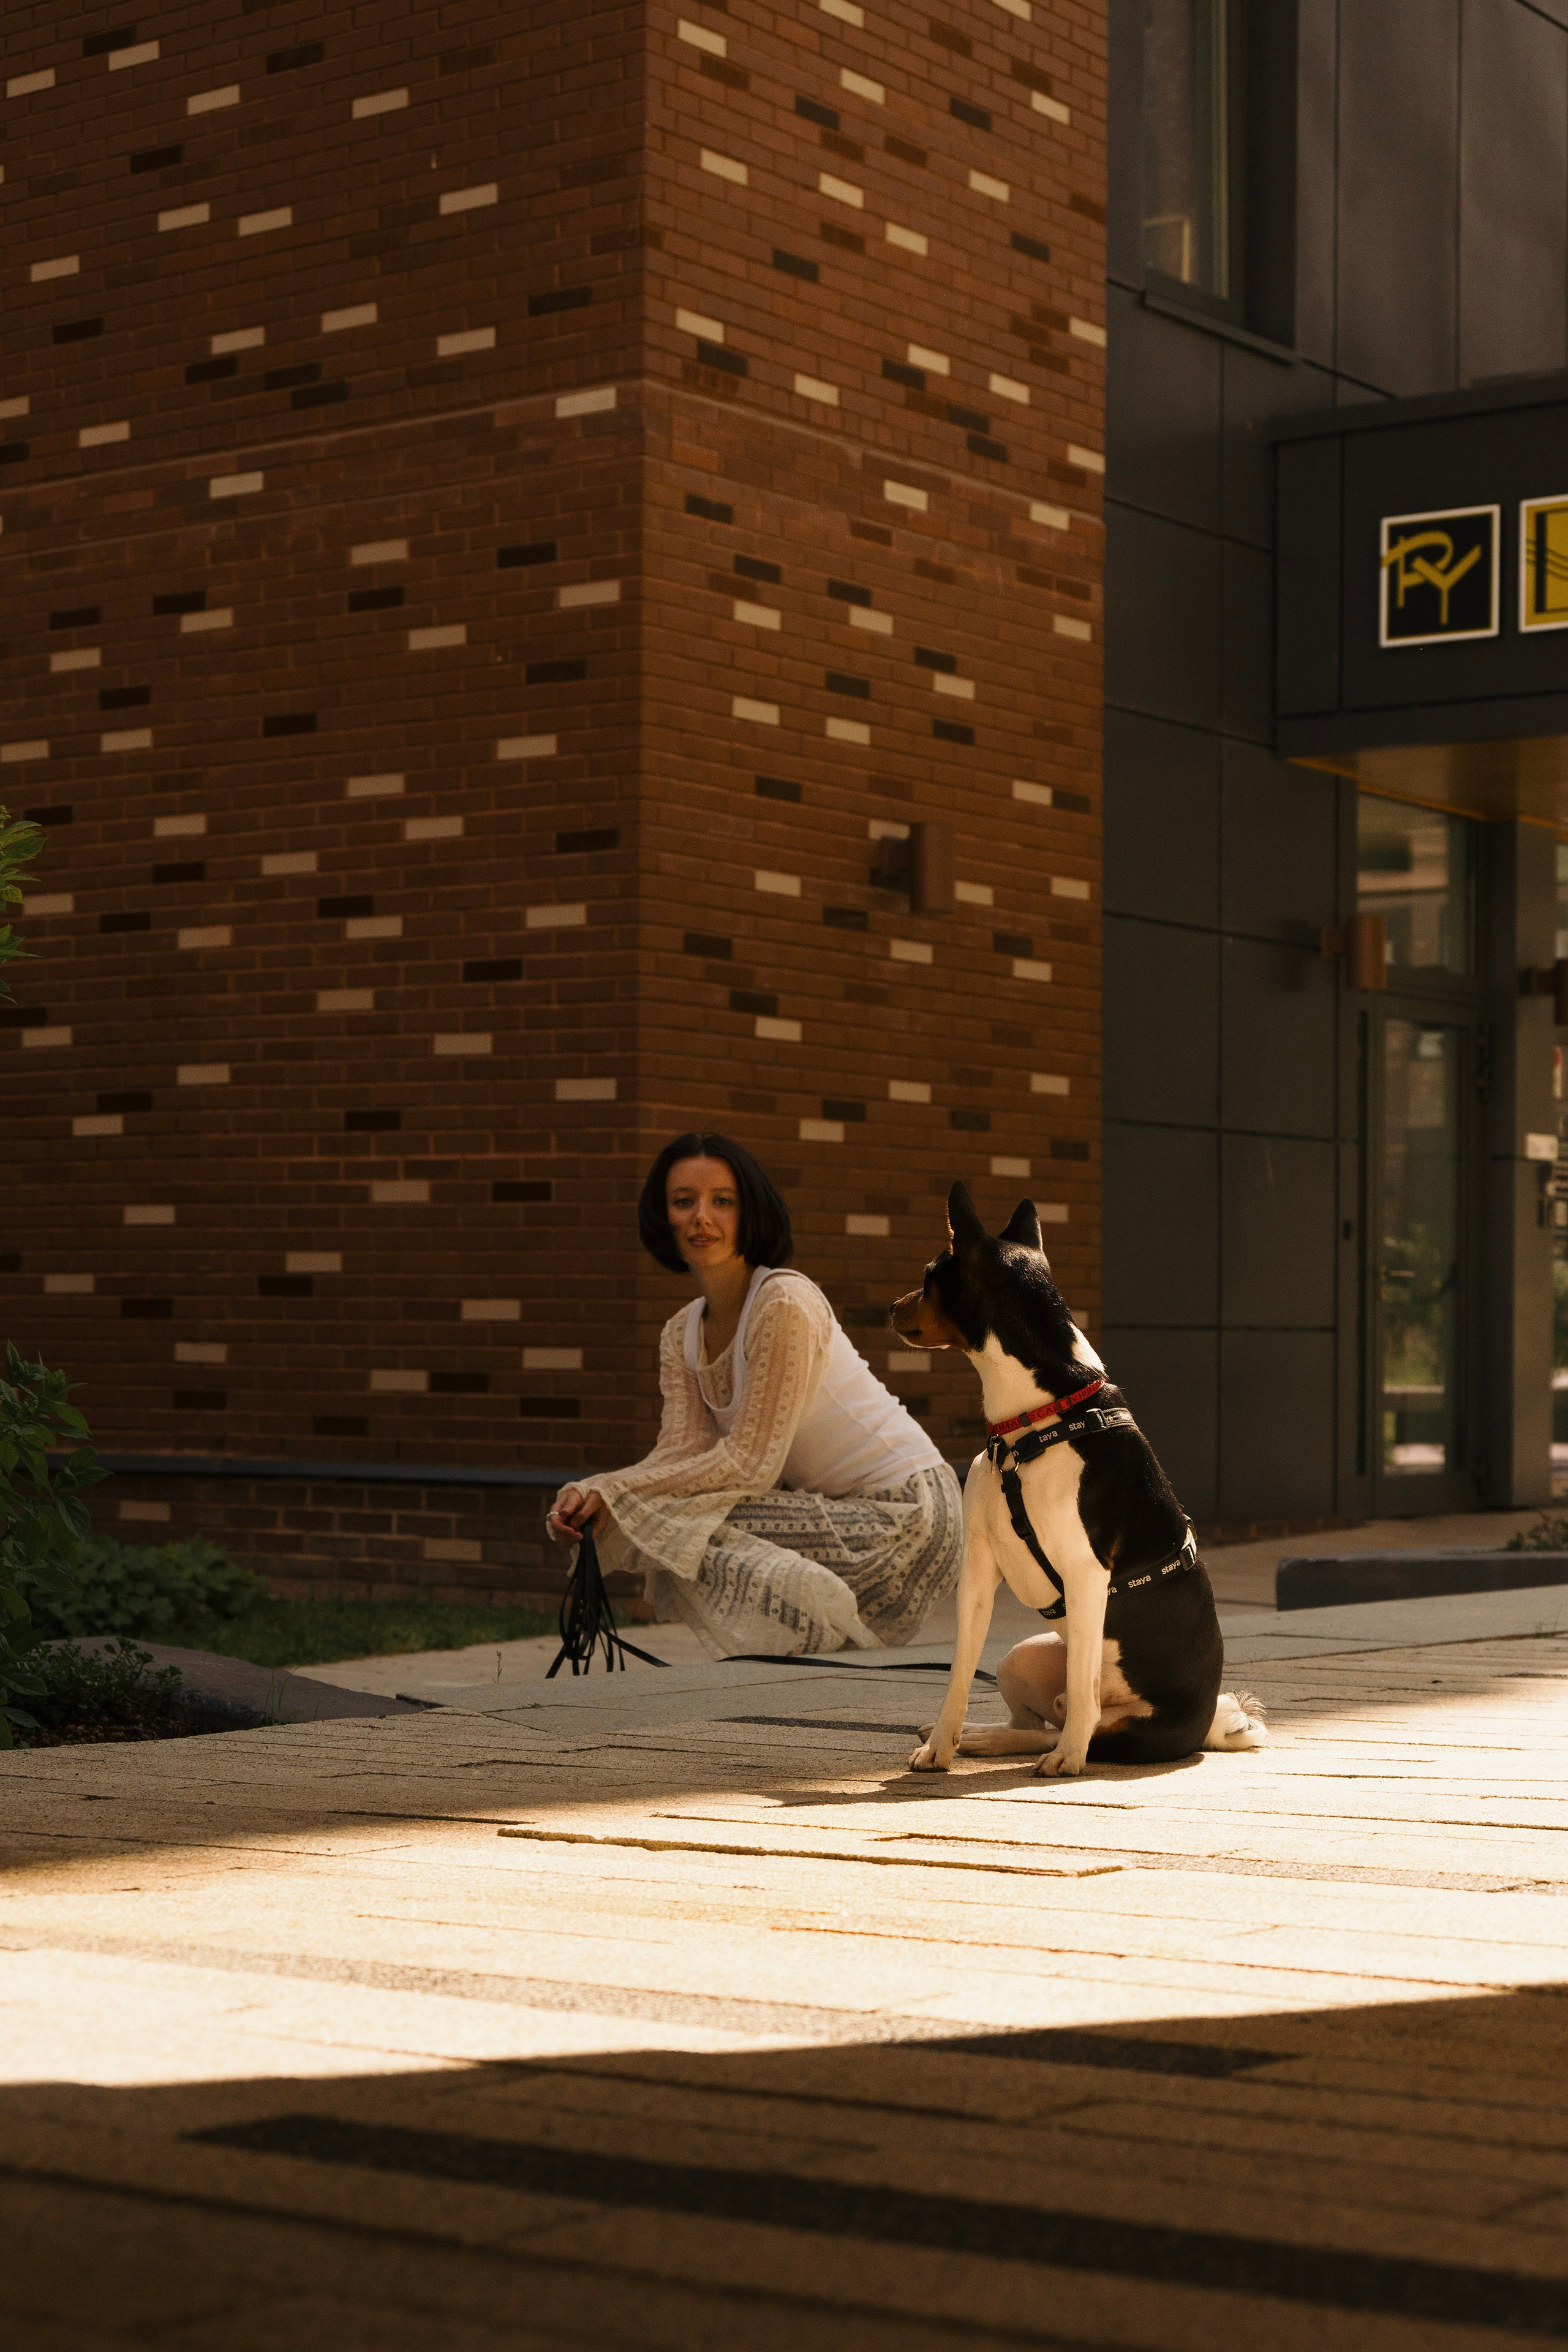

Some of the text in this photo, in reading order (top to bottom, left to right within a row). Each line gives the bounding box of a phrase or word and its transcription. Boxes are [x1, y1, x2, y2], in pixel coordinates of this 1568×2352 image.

[1038, 1420, 1085, 1442] taya stay
[1128, 1575, 1152, 1588] staya
[1161, 1559, 1181, 1575] staya
